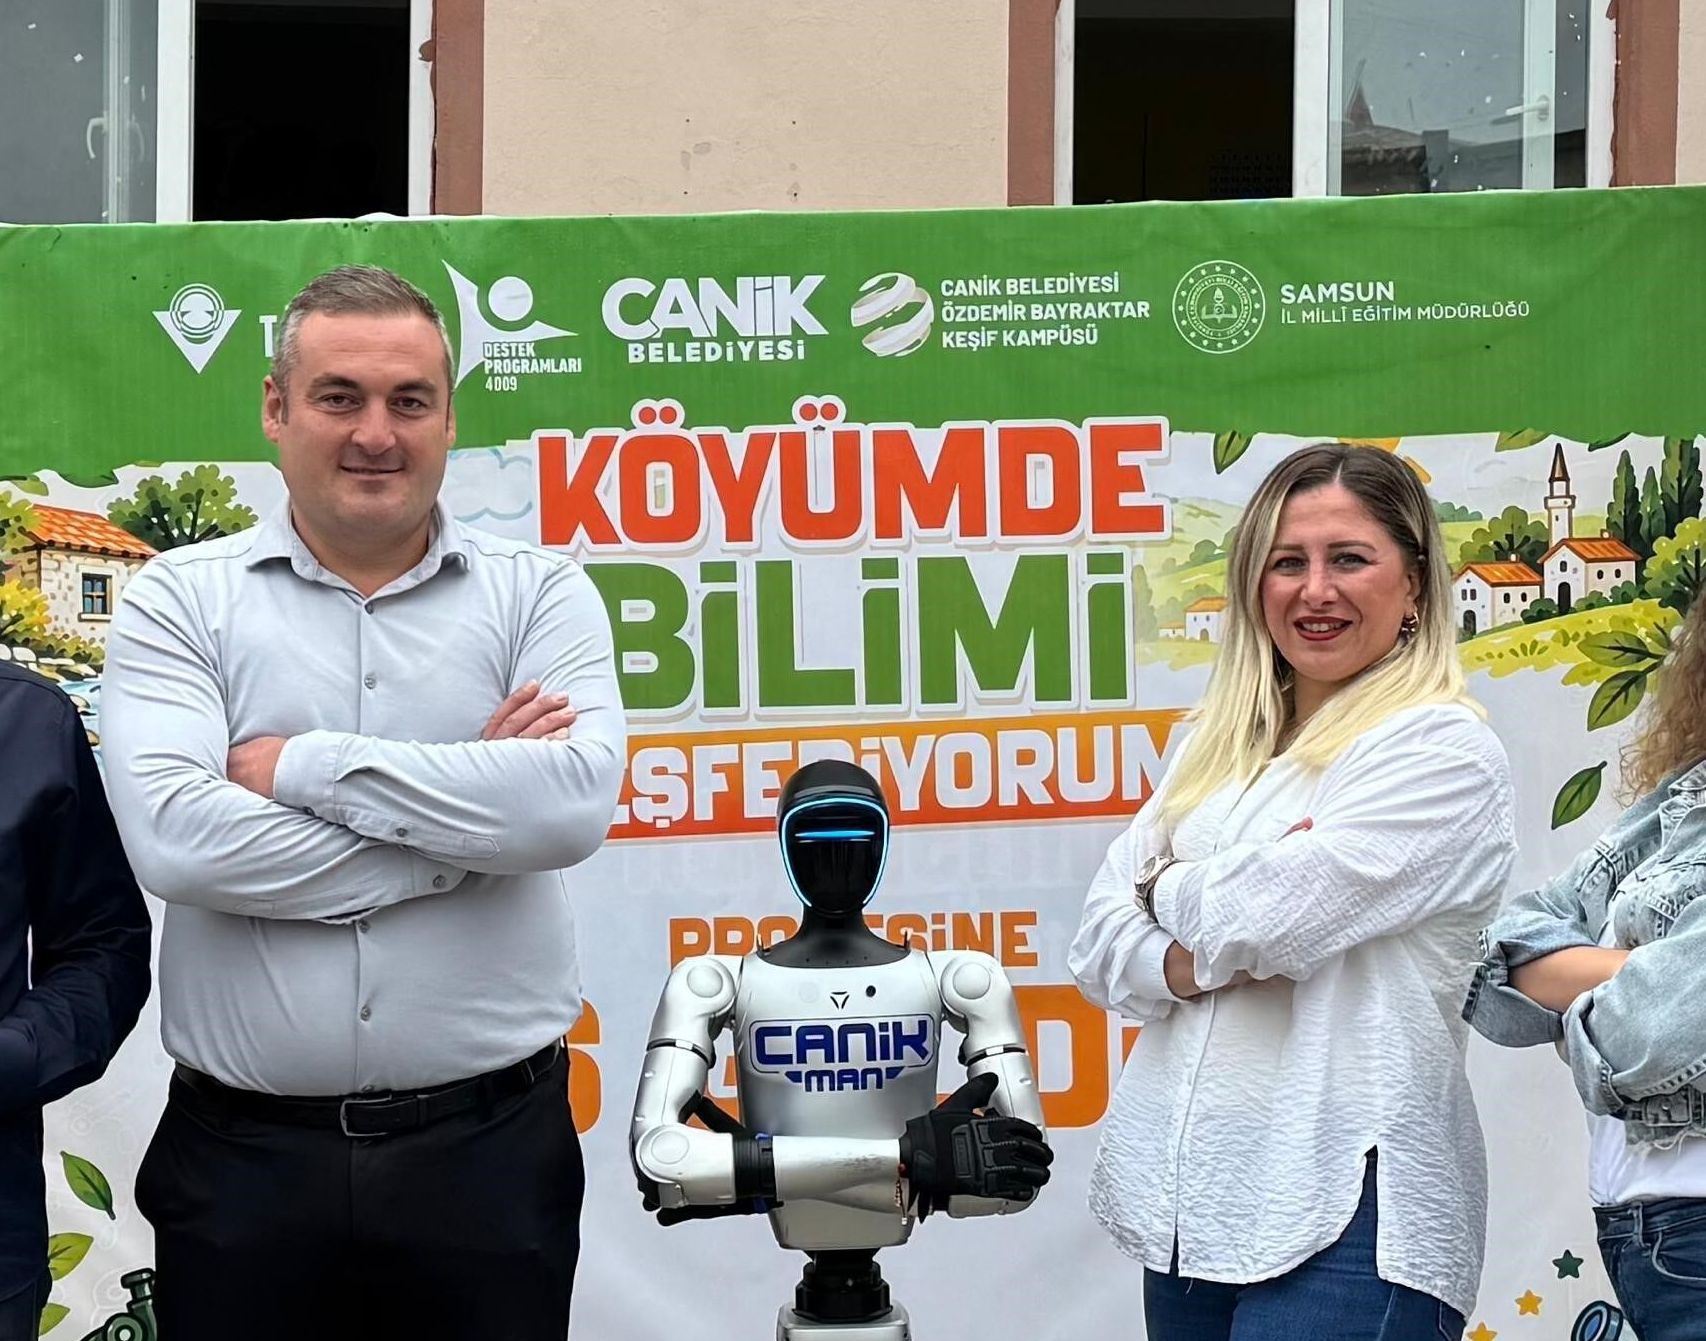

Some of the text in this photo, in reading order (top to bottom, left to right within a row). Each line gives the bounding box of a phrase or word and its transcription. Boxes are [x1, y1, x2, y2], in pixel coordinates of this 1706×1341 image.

[940, 270, 1120, 297] CANİK BELEDİYESİ
[1280, 280, 1395, 305] SAMSUN
[941, 299, 1150, 323] ÖZDEMİR BAYRAKTAR
[1281, 307, 1297, 325] İL
[1351, 304, 1412, 323] EĞİTİM
[1417, 300, 1530, 320] MÜDÜRLÜĞÜ
[942, 322, 1099, 352] KEŞİF KAMPÜSÜ
[483, 342, 536, 358] DESTEK
[483, 358, 583, 375] PROGRAMLARI
[485, 375, 518, 392] 4009
[537, 400, 1166, 546] KÖYÜMDE
